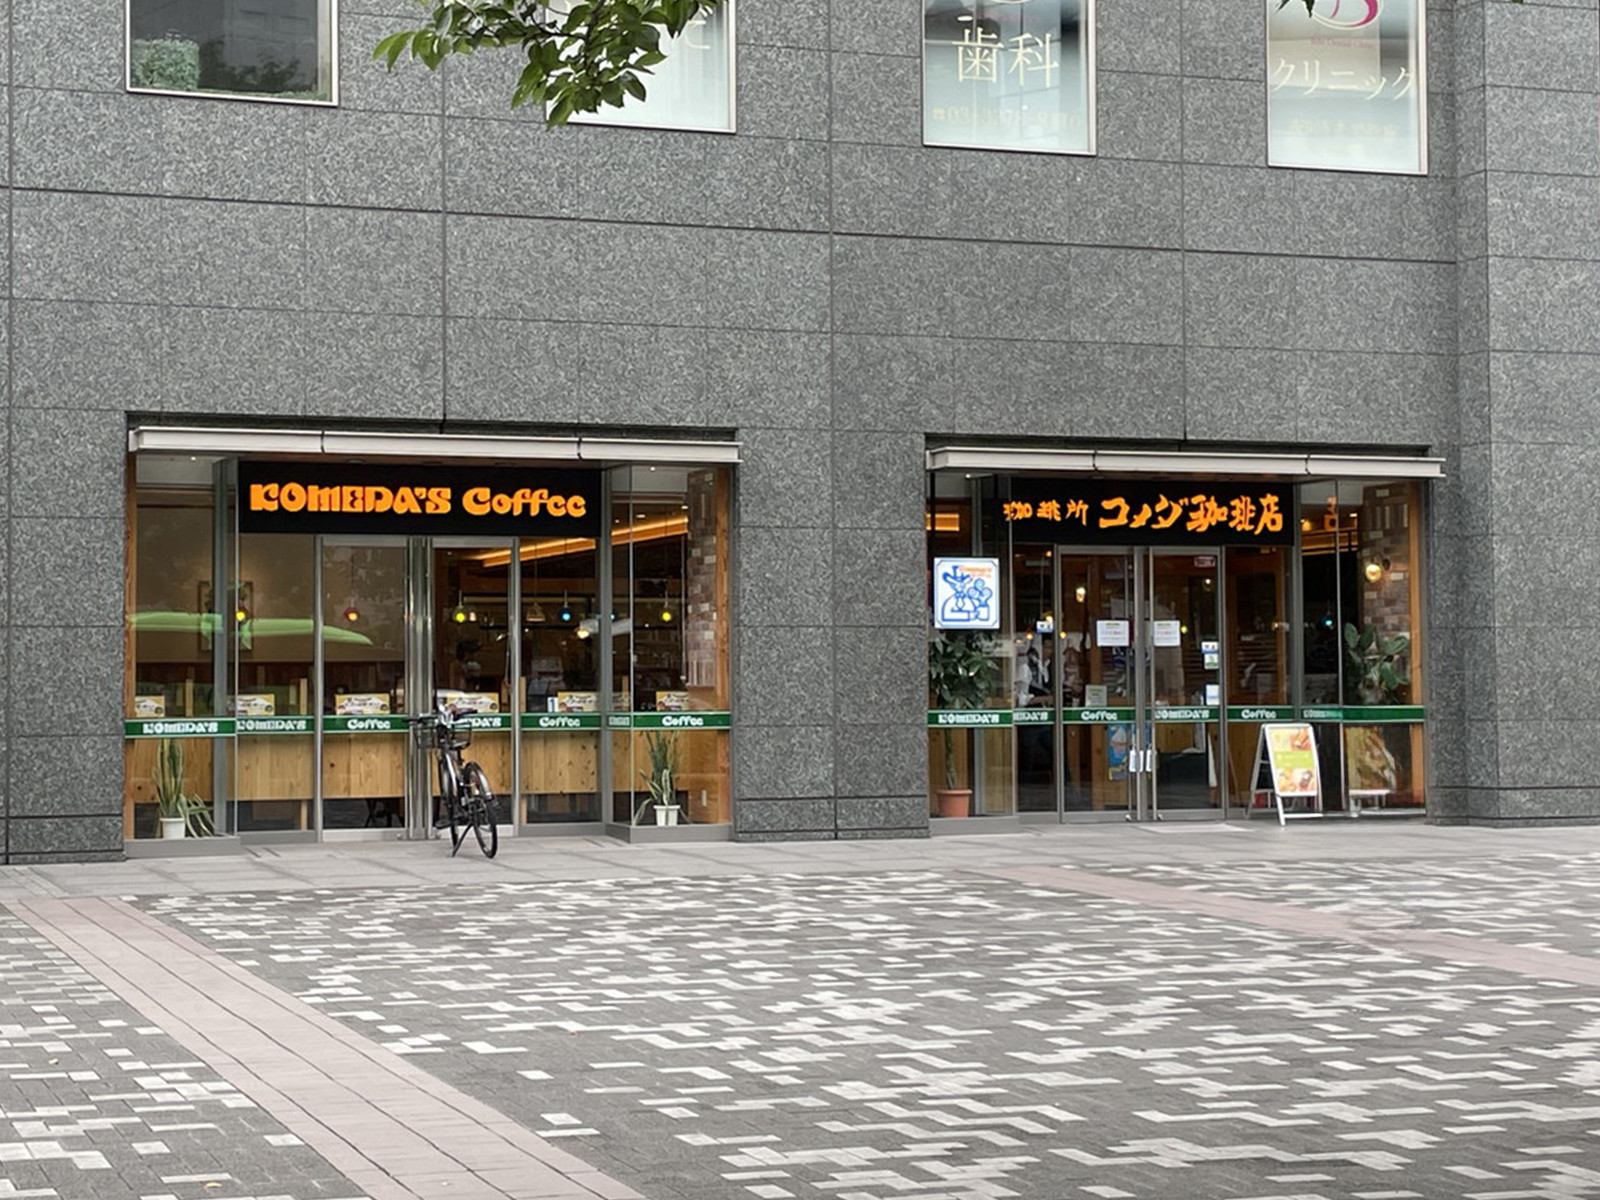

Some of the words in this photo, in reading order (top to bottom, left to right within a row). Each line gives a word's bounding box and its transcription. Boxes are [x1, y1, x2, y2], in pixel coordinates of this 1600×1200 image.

[951, 27, 1060, 88] 歯科
[1271, 57, 1415, 101] クリニック
[249, 482, 452, 514] KOMEDA'S
[462, 487, 587, 517] Coffee
[1002, 498, 1090, 526] 珈琲所
[1098, 493, 1284, 535] コメダ珈琲店
[937, 713, 1000, 724] KOMEDA'S
[1080, 710, 1118, 721] Coffee
[1240, 709, 1277, 719] Coffee
[236, 719, 307, 731] KOMEDA'S
[347, 718, 391, 731] Coffee
[538, 716, 581, 728] Coffee
[662, 715, 704, 727] Coffee
[142, 721, 219, 734] KOMEDA'S
